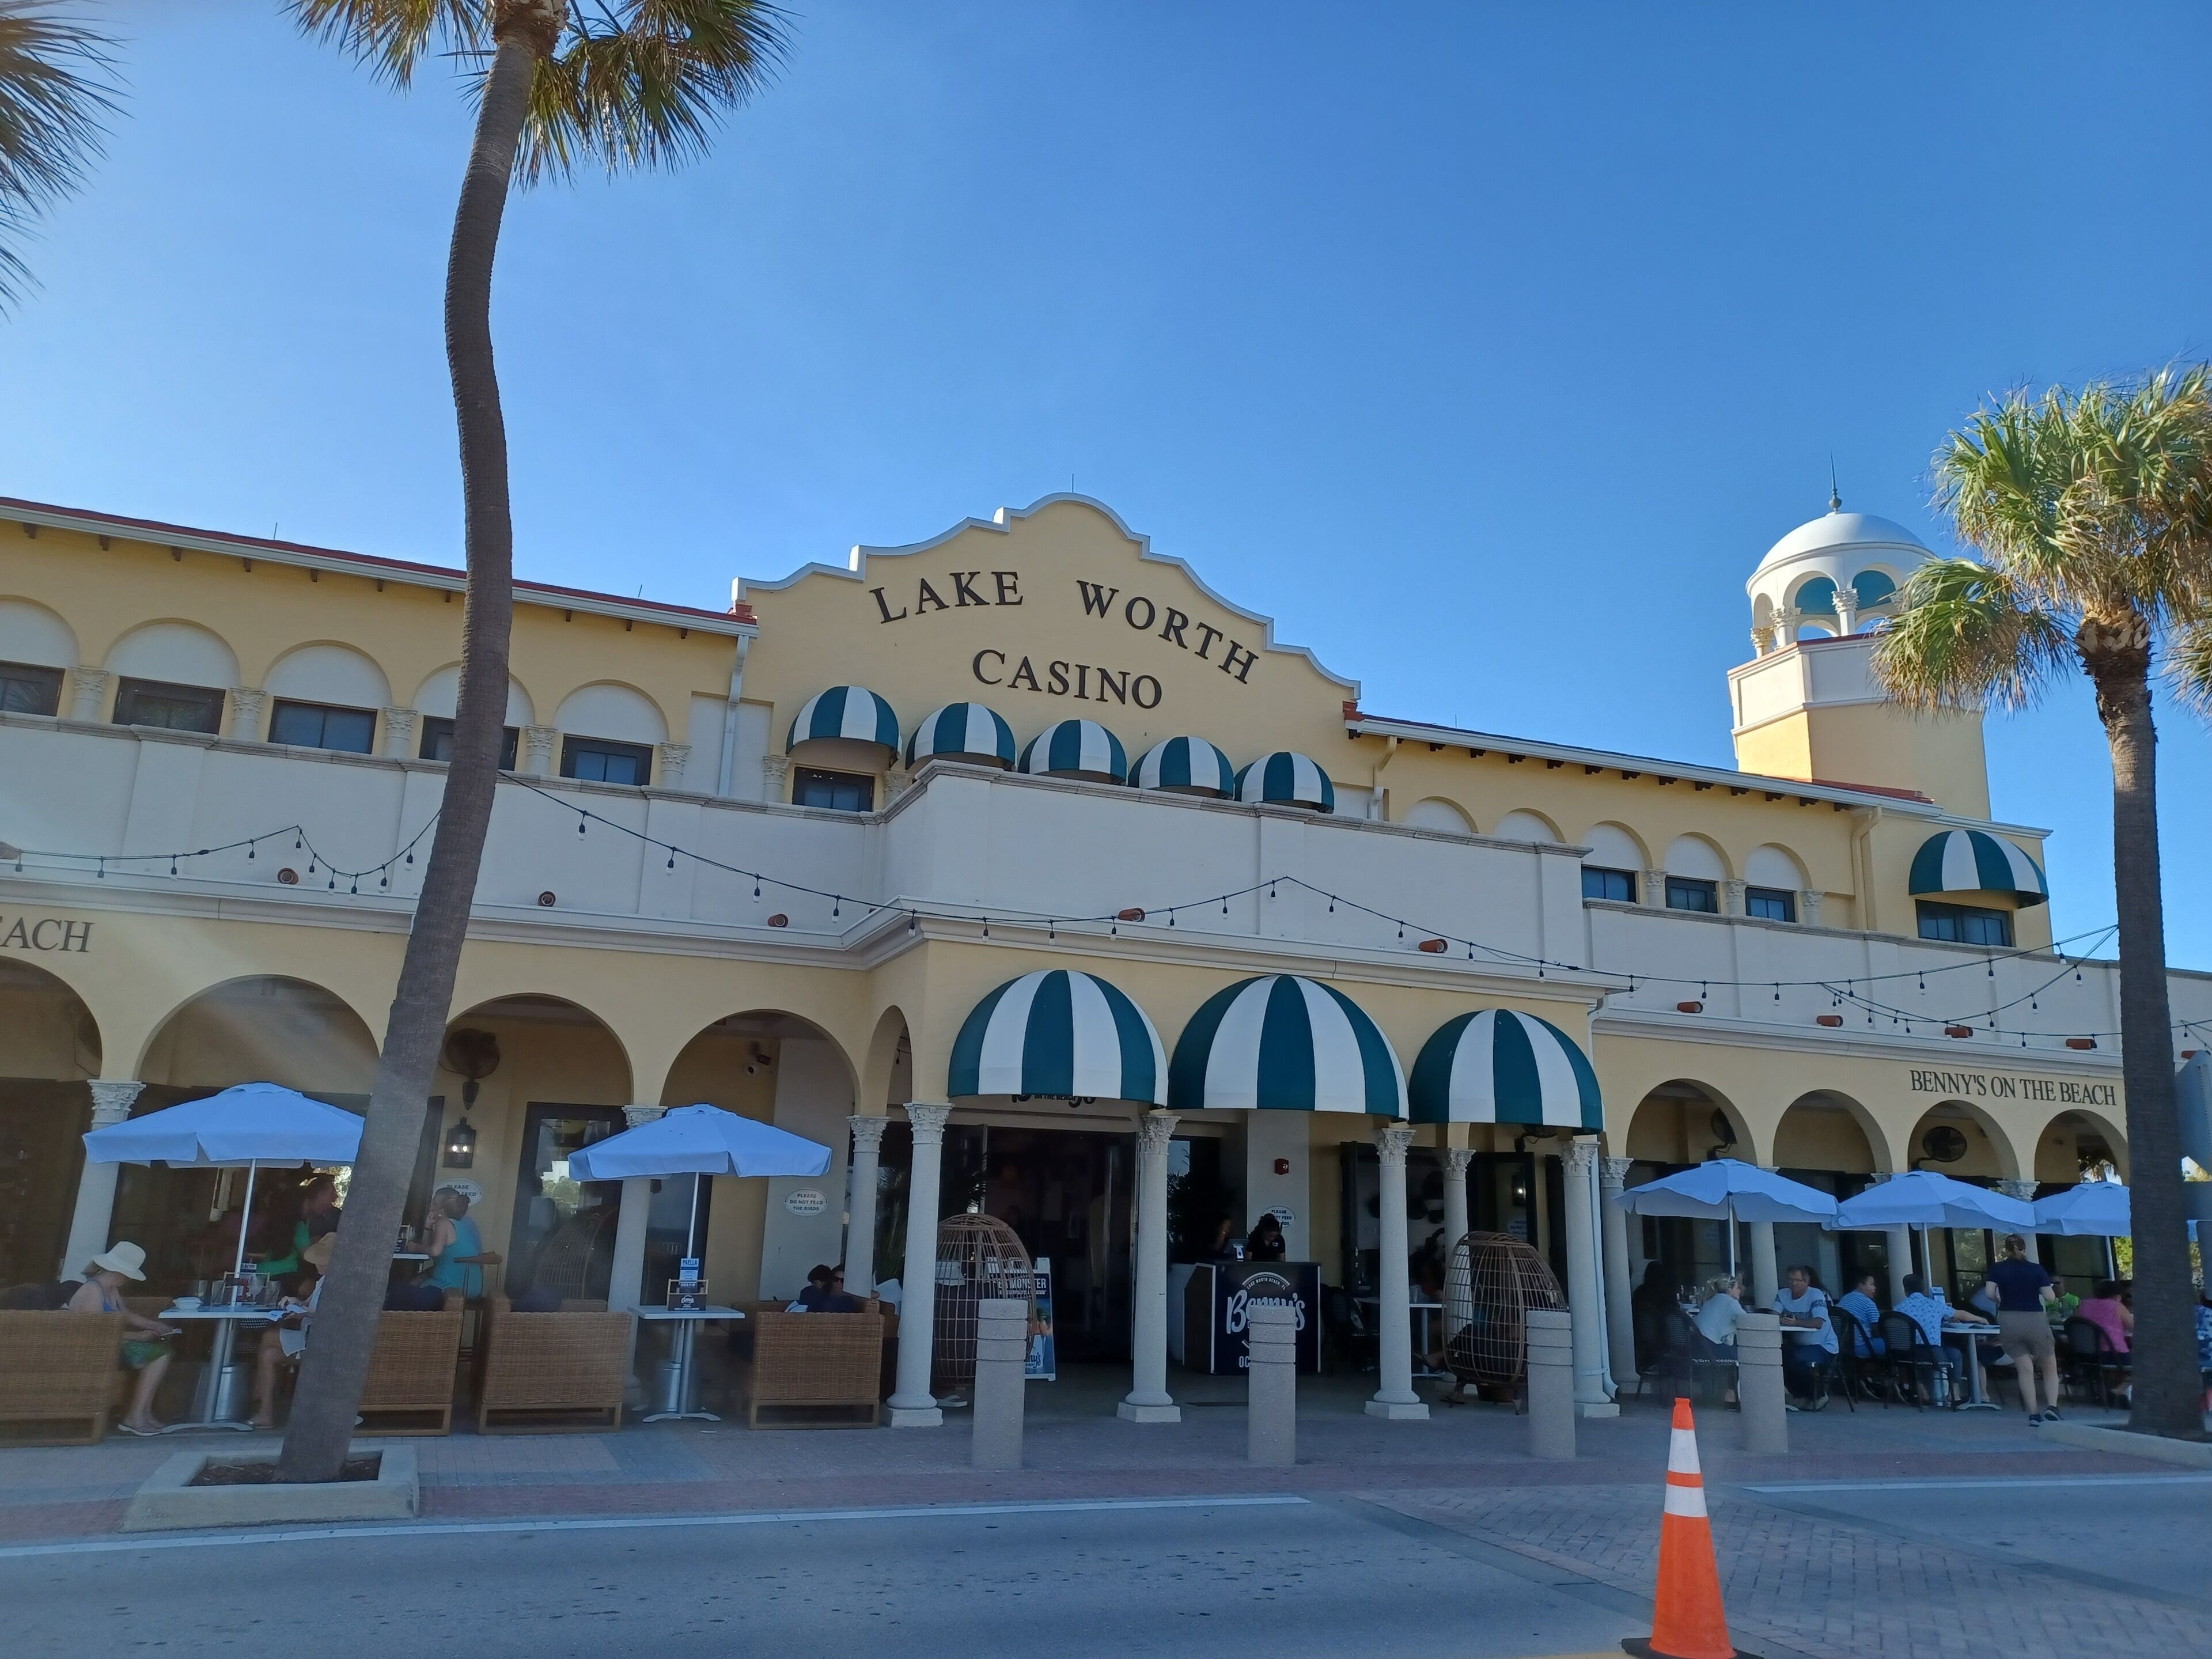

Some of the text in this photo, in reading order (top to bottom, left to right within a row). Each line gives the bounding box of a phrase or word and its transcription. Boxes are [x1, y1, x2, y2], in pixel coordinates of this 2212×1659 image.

[869, 571, 1260, 684] LAKE WORTH
[972, 649, 1162, 709] CASINO
[0, 916, 95, 953] ACH
[1910, 1070, 2117, 1105] BENNY'S ON THE BEACH
[1009, 1278, 1046, 1289] MONSER
[1226, 1290, 1305, 1334] Be's
